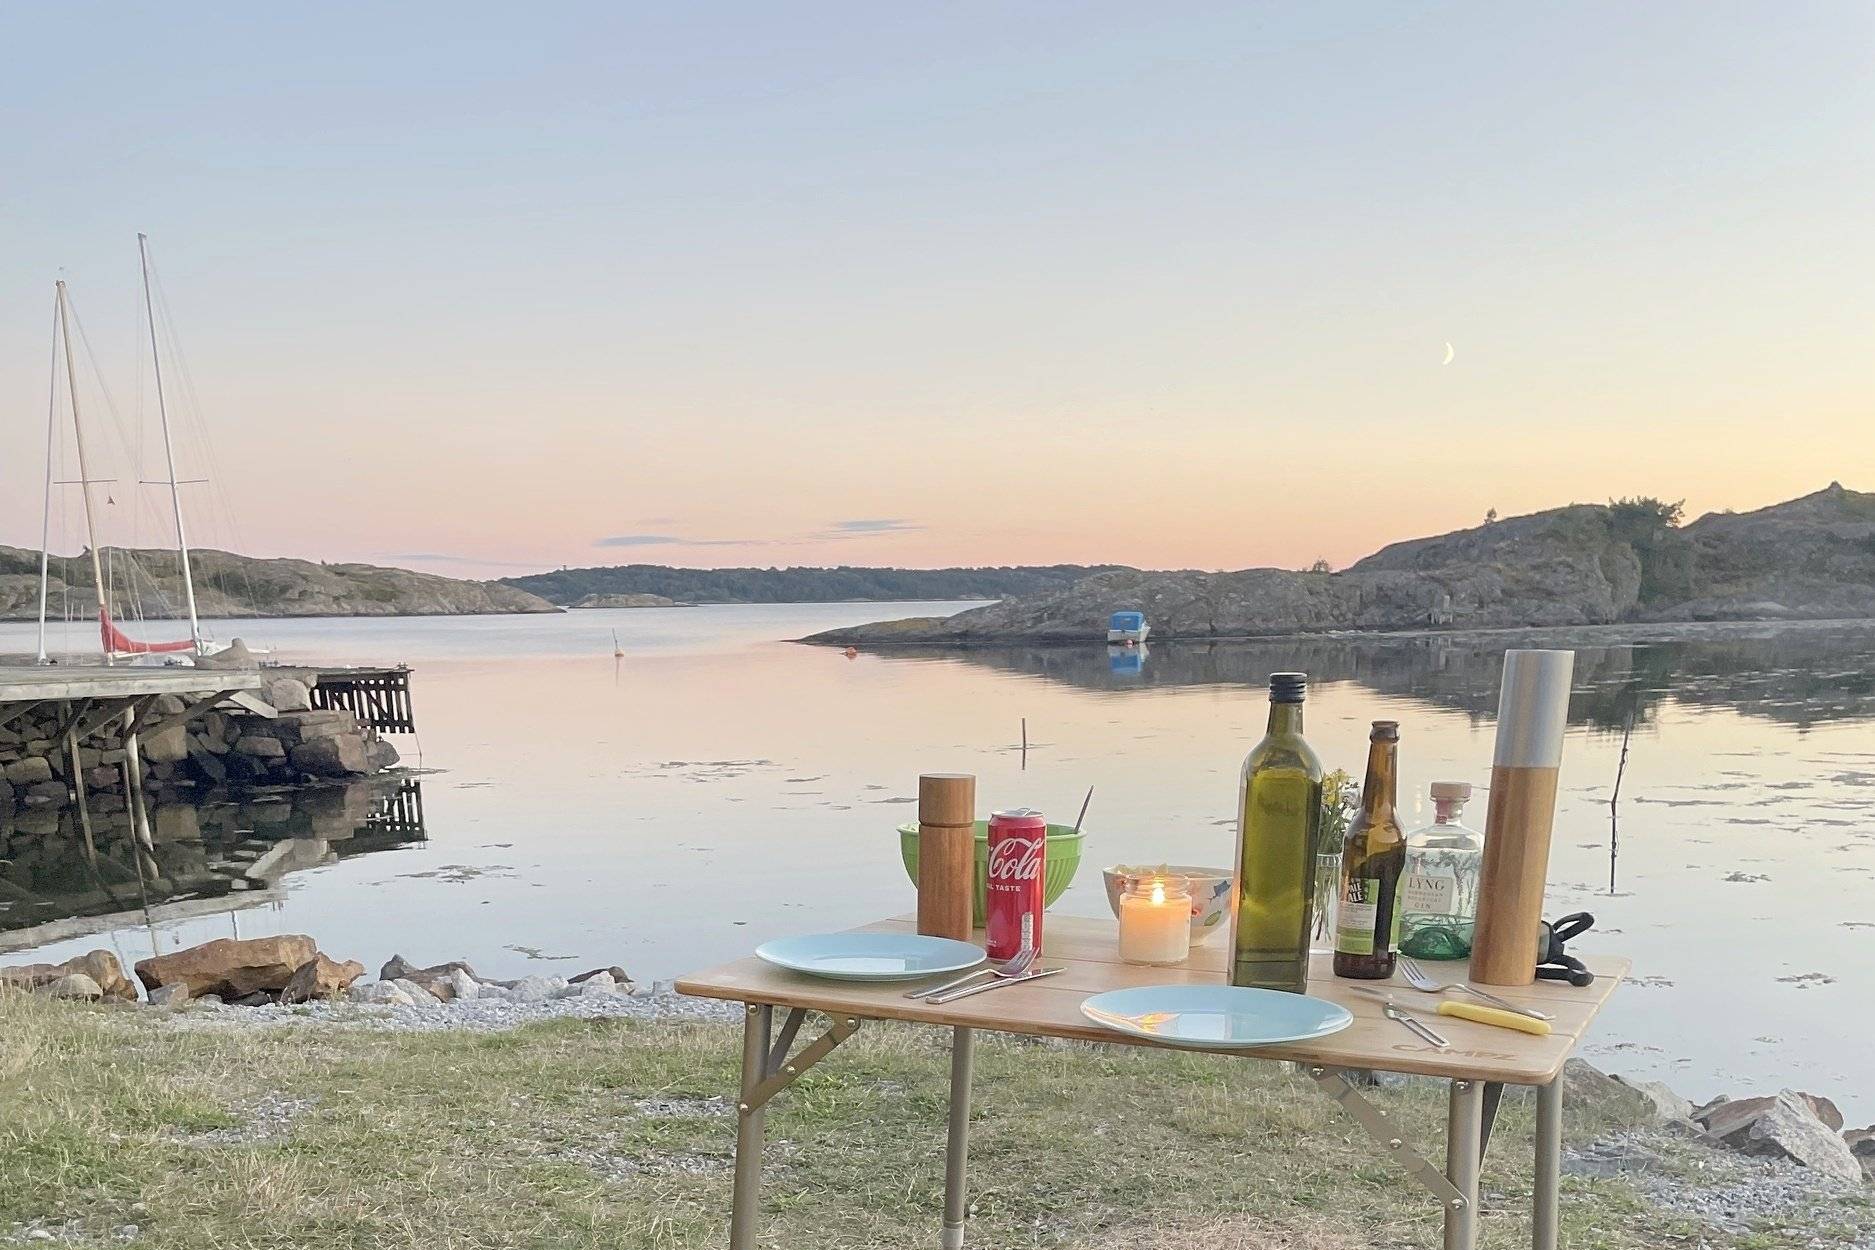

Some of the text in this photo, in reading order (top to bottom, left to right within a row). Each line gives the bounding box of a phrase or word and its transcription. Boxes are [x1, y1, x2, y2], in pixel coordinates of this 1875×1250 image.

[989, 837, 1044, 880] Cola
[995, 884, 1021, 892] TASTE
[1408, 877, 1445, 891] LYNG
